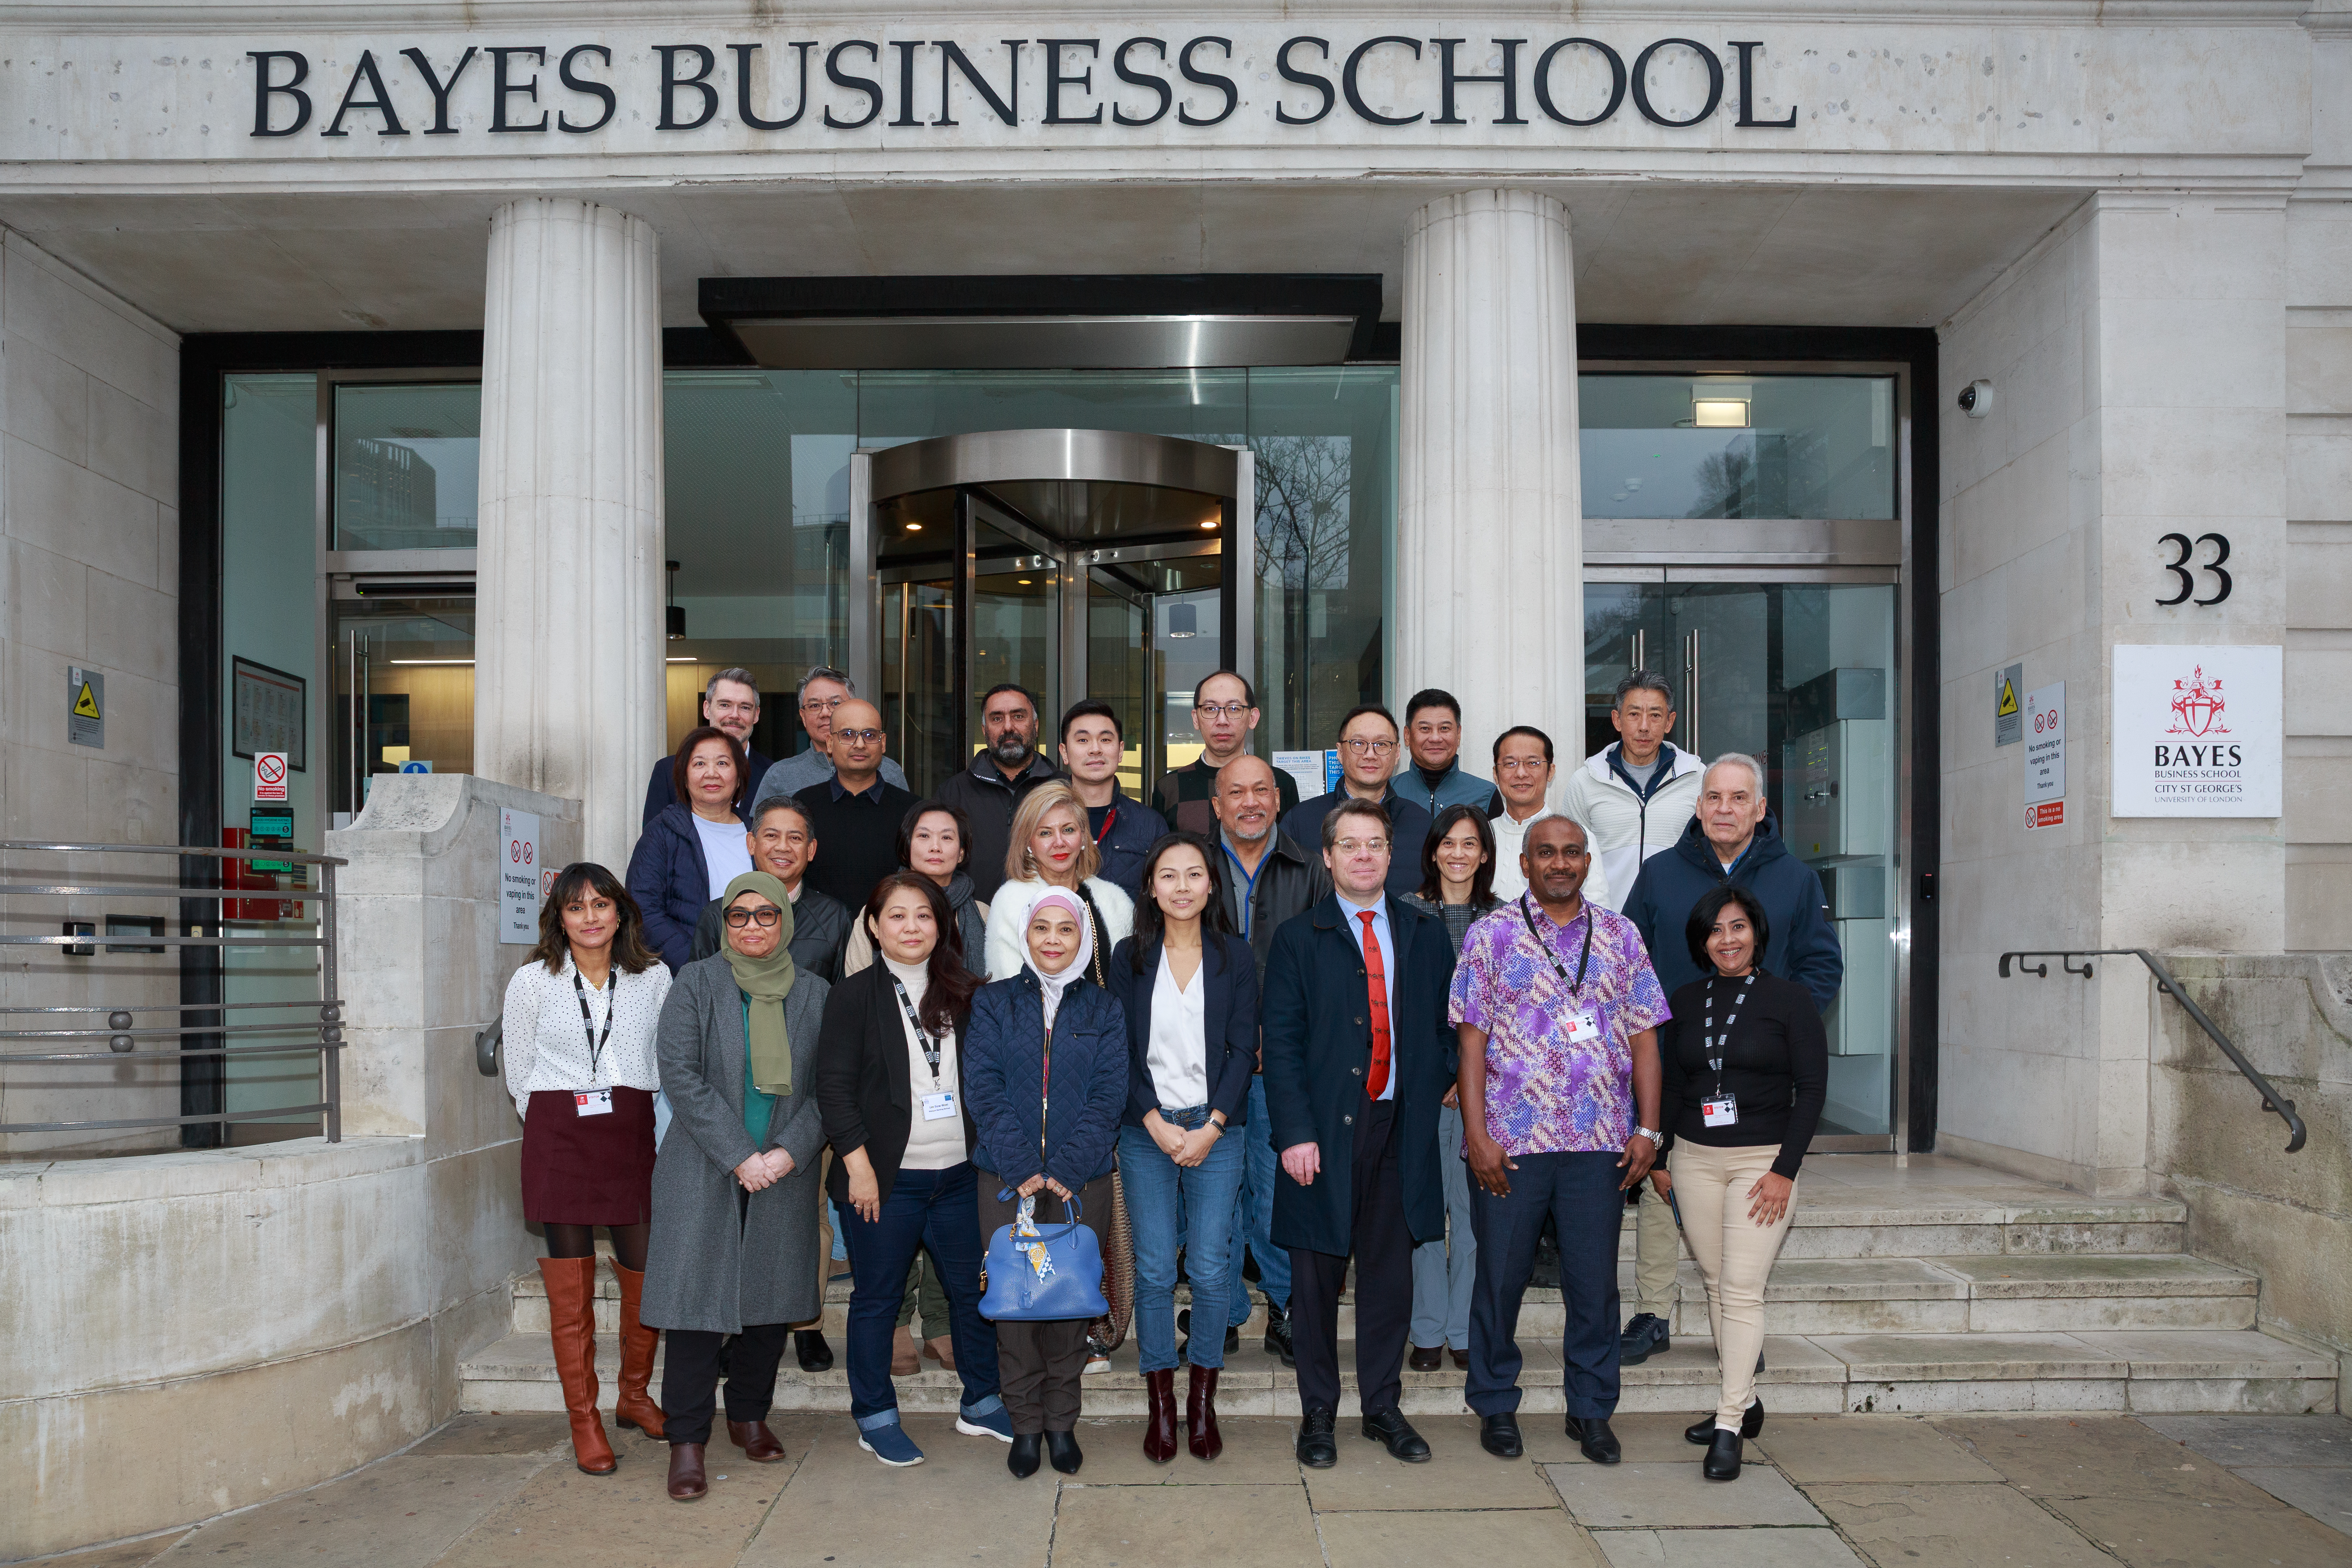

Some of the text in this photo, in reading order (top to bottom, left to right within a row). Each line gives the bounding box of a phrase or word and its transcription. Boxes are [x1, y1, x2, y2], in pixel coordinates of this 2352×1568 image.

[246, 36, 1798, 137] BAYES BUSINESS SCHOOL
[2155, 532, 2232, 606] 33
[2029, 745, 2035, 753] No
[2036, 740, 2055, 750] smoking
[2030, 756, 2045, 766] vaping
[2051, 751, 2060, 760] this
[2155, 746, 2242, 767] BAYES
[2155, 770, 2242, 778] BUSINESS SCHOOL
[2037, 781, 2047, 789] Thank
[2155, 785, 2178, 793] CITY
[2195, 784, 2242, 793] GEORGE'S
[2038, 815, 2054, 824] smoking
[505, 873, 511, 882] No
[512, 874, 530, 886] smoking
[506, 889, 521, 900] vaping
[522, 891, 526, 899] in
